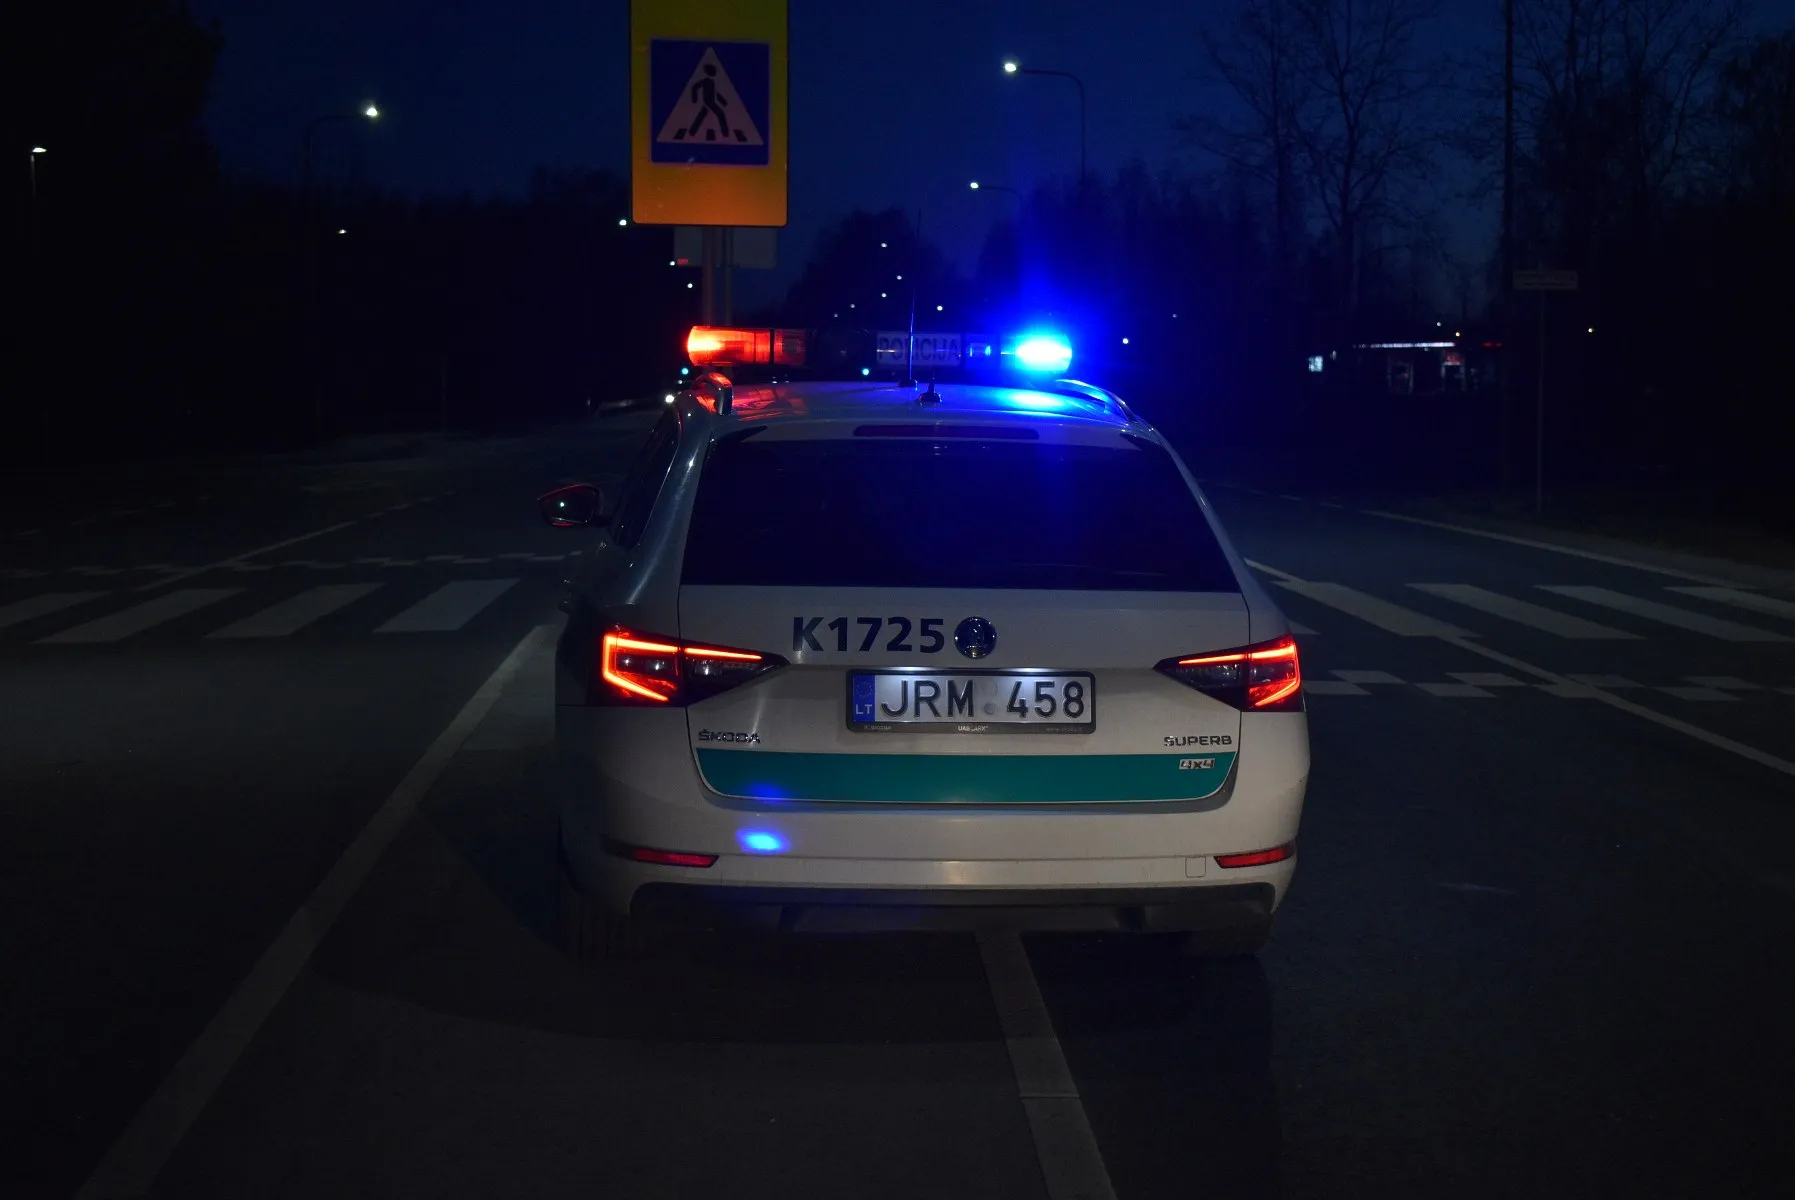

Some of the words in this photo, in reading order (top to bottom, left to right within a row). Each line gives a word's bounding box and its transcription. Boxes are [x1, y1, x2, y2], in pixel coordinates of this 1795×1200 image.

[792, 616, 945, 654] K1725
[855, 703, 873, 716] LT
[880, 679, 975, 718] JRM
[1006, 680, 1085, 719] 458
[1163, 735, 1233, 747] SUPERB
